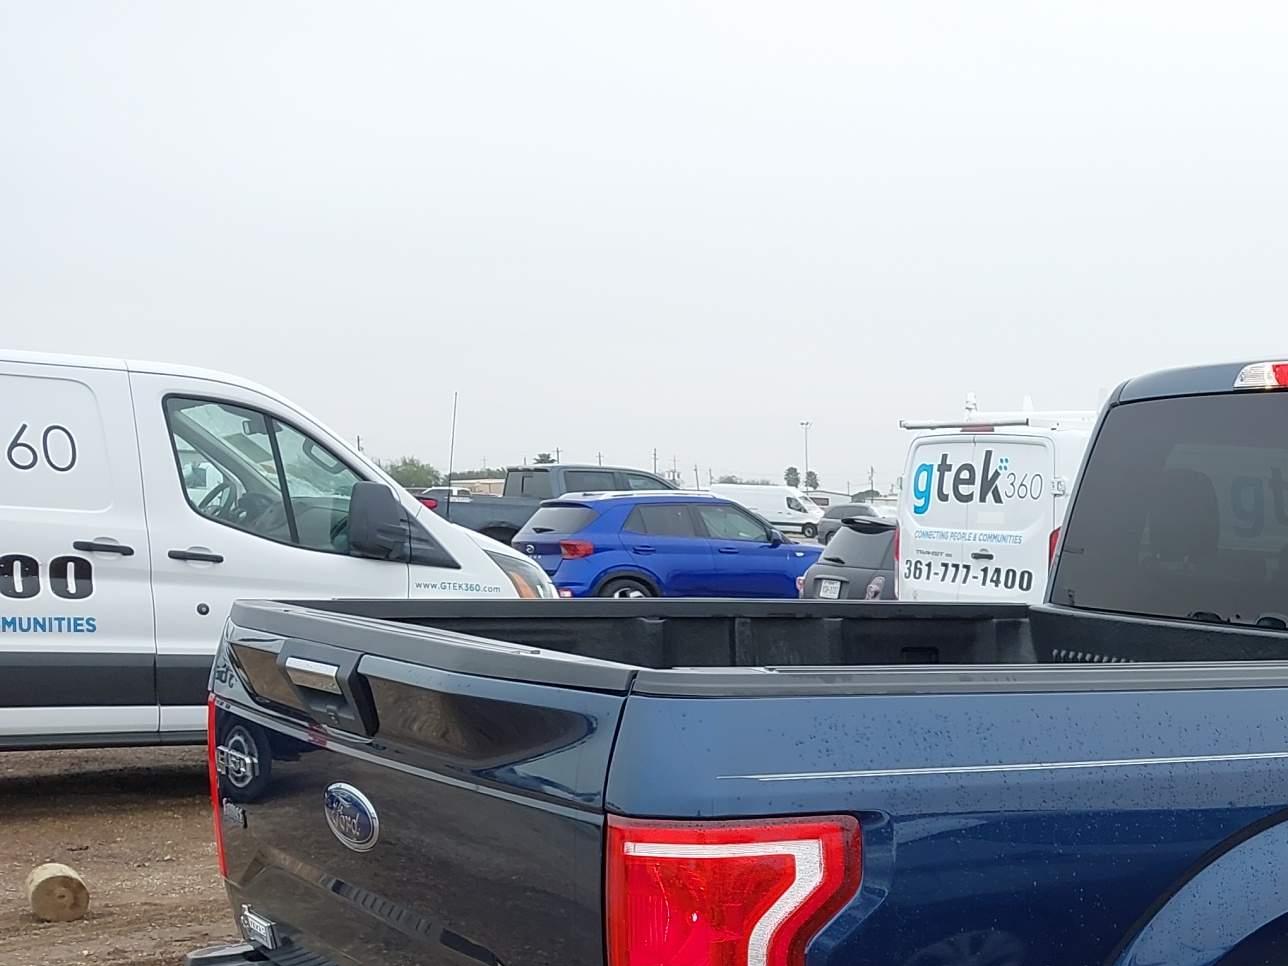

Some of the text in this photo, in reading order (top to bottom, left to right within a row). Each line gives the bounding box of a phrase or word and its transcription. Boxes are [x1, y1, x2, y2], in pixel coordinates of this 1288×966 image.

[914, 530, 949, 540] CONNECTING
[950, 531, 972, 541] PEOPLE
[979, 533, 1023, 544] COMMUNITIES
[415, 582, 501, 593] www.GTEK360.com
[904, 560, 1033, 592] 361-777-1400
[327, 793, 361, 839] Ford
